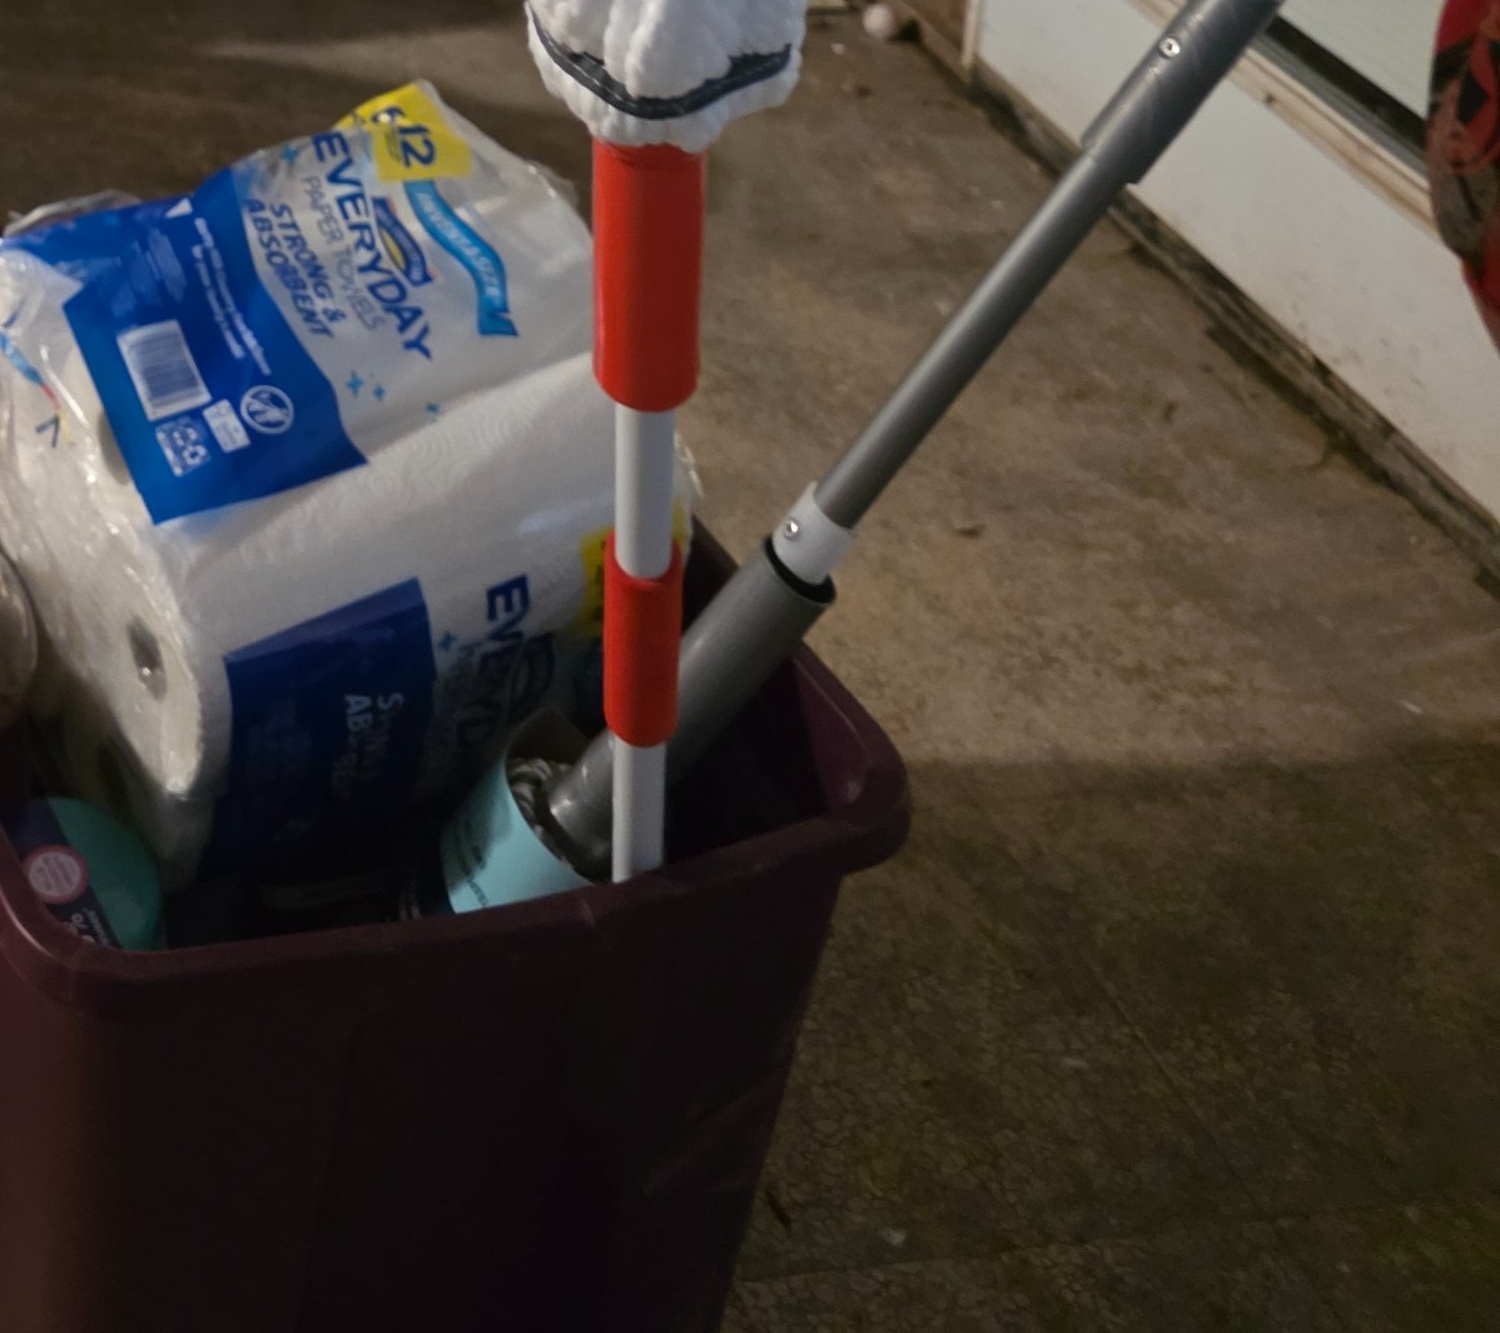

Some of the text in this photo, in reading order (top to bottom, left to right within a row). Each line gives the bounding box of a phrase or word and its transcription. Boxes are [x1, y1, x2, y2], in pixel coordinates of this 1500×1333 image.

[399, 124, 436, 169] 12
[270, 201, 335, 300] STRONG
[302, 175, 345, 246] PAPER
[311, 131, 433, 361] EVERYDAY
[242, 198, 335, 339] ABSORBENT
